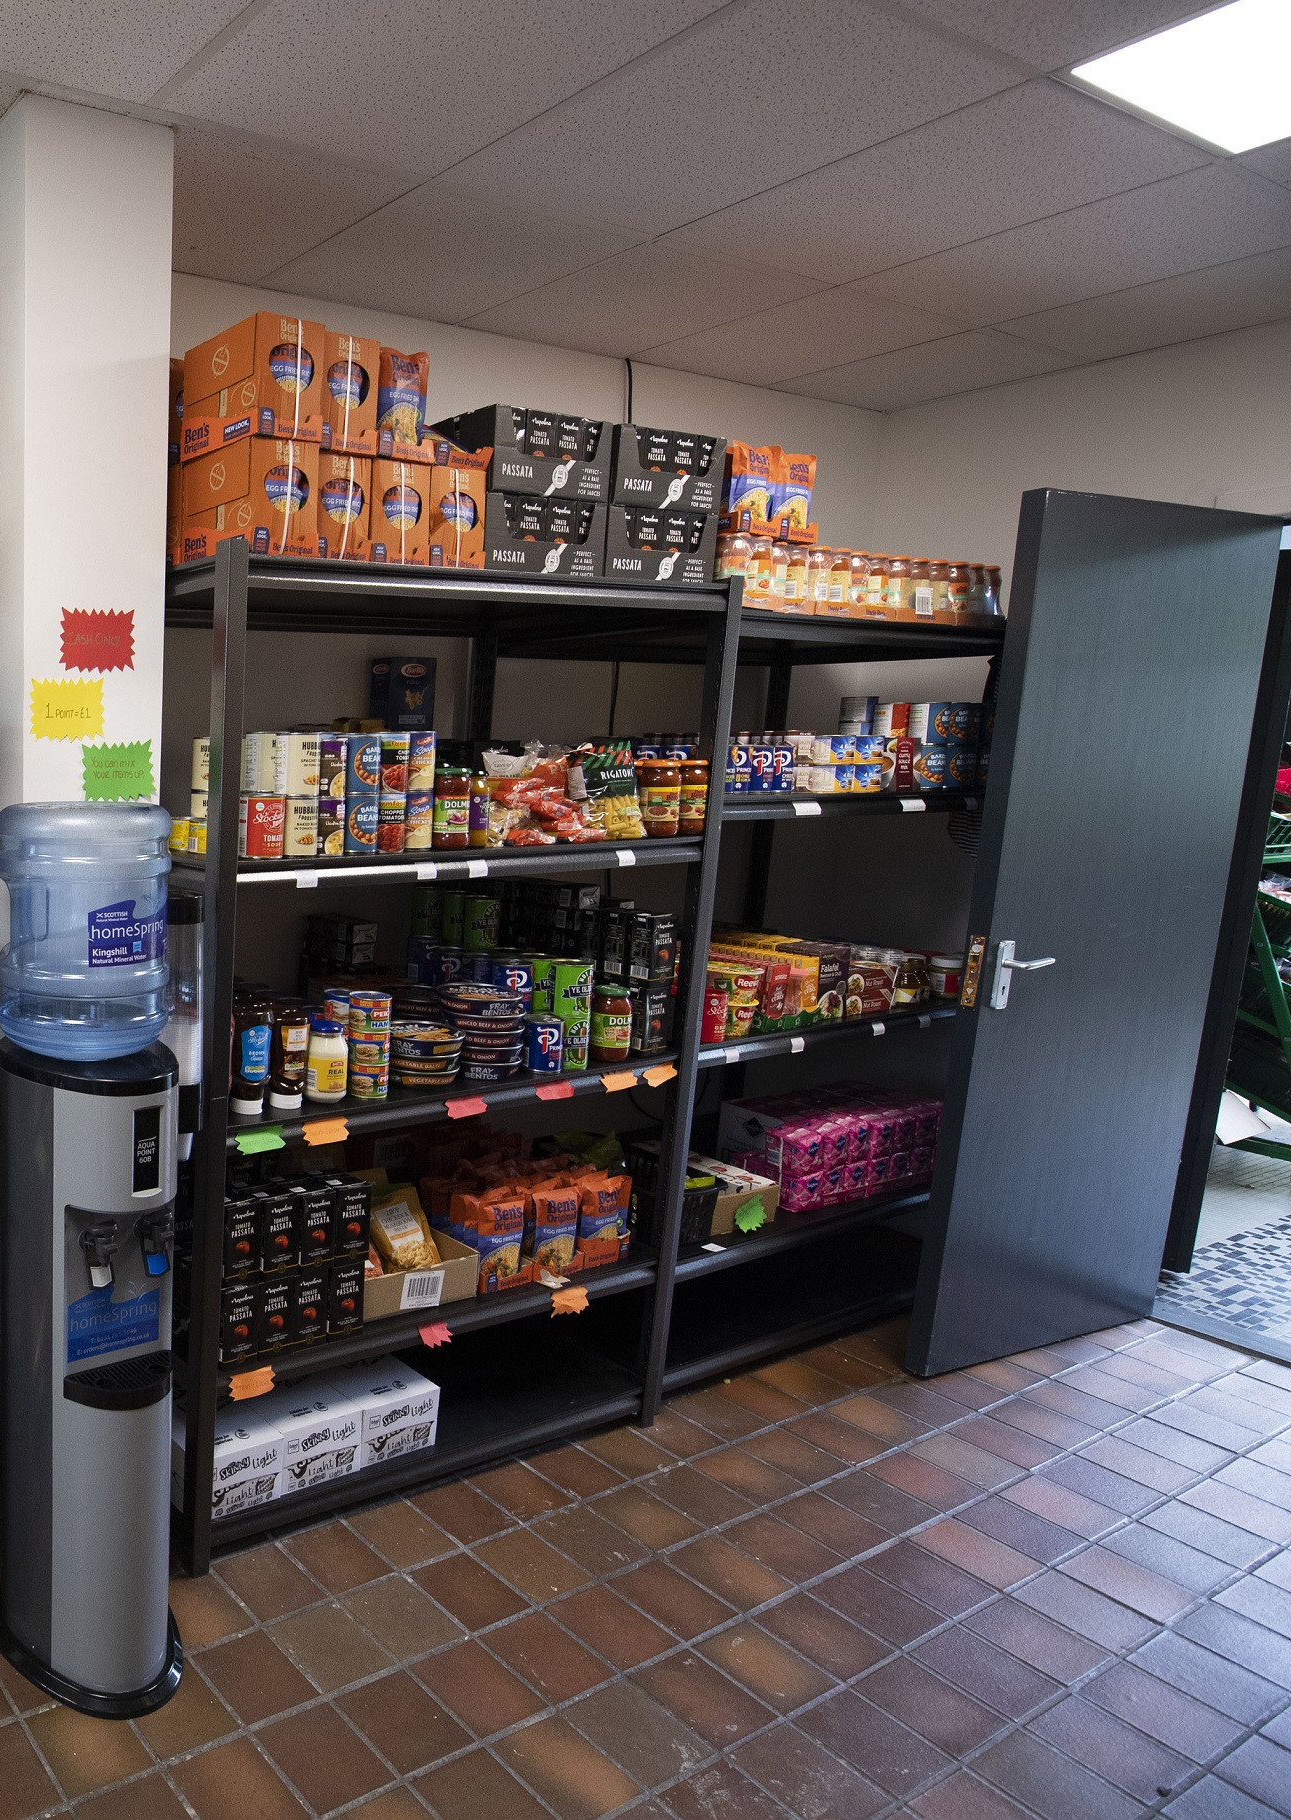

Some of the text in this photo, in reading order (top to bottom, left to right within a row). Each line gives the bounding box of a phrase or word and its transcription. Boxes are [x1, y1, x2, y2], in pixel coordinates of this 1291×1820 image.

[184, 423, 209, 445] Ben's
[184, 440, 209, 455] Original
[530, 437, 550, 446] PASSATA
[502, 463, 534, 479] PASSATA
[623, 478, 652, 492] PASSATA
[493, 549, 525, 563] PASSATA
[613, 558, 642, 571] PASSATA
[600, 768, 634, 780] RIGATONI
[91, 919, 164, 940] homeSpring
[92, 947, 128, 958] Kingshill
[114, 955, 134, 964] Mineral
[134, 954, 147, 962] Water
[821, 963, 839, 973] Falafel
[465, 1072, 498, 1080] BENTOS
[137, 1141, 156, 1150] AQUA
[136, 1148, 156, 1157] POINT
[139, 1156, 152, 1164] 60B
[342, 1208, 365, 1219] PASSATA
[493, 1205, 523, 1220] Ben's
[494, 1221, 523, 1231] Original
[231, 1227, 254, 1238] PASSATA
[71, 1302, 156, 1332] homeSpring
[411, 1398, 433, 1417] Light
[382, 1405, 410, 1426] SKINNY
